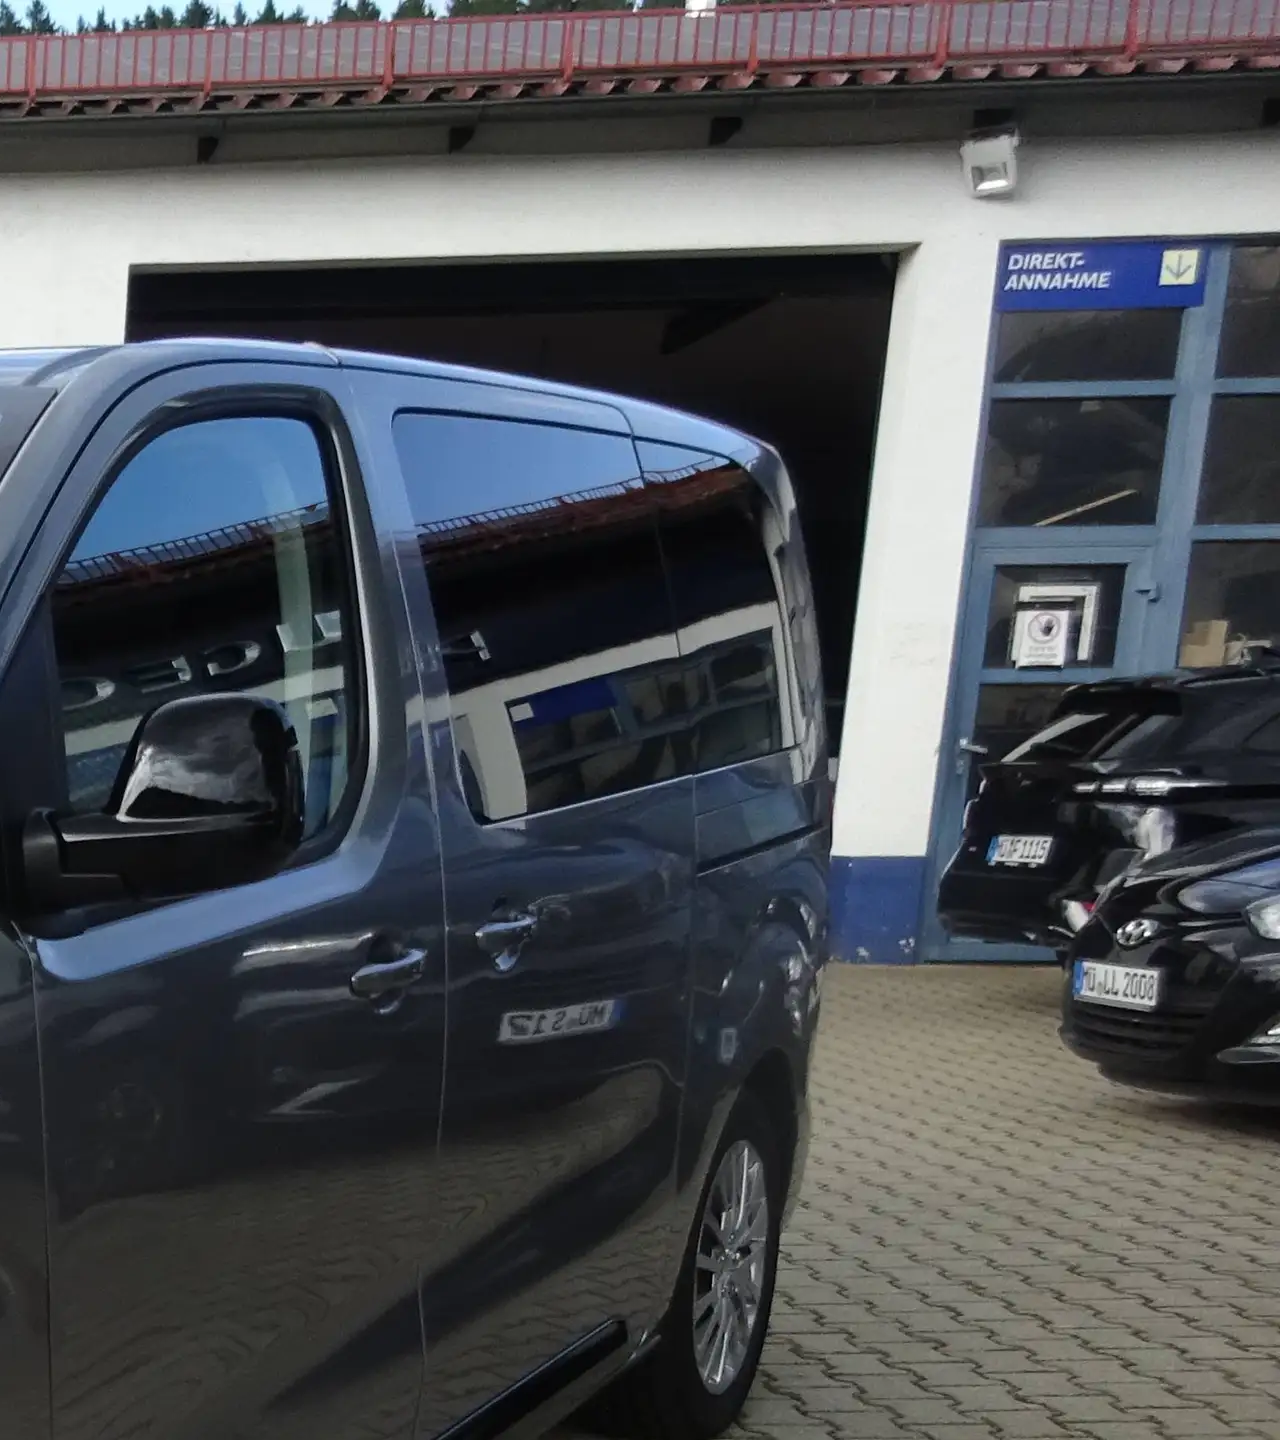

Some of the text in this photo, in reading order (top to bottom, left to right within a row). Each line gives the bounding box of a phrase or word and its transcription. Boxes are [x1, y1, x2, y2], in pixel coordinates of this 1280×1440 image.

[1007, 252, 1085, 271] DIREKT-
[1004, 271, 1112, 291] ANNAHME
[1122, 971, 1155, 1002] 2008
